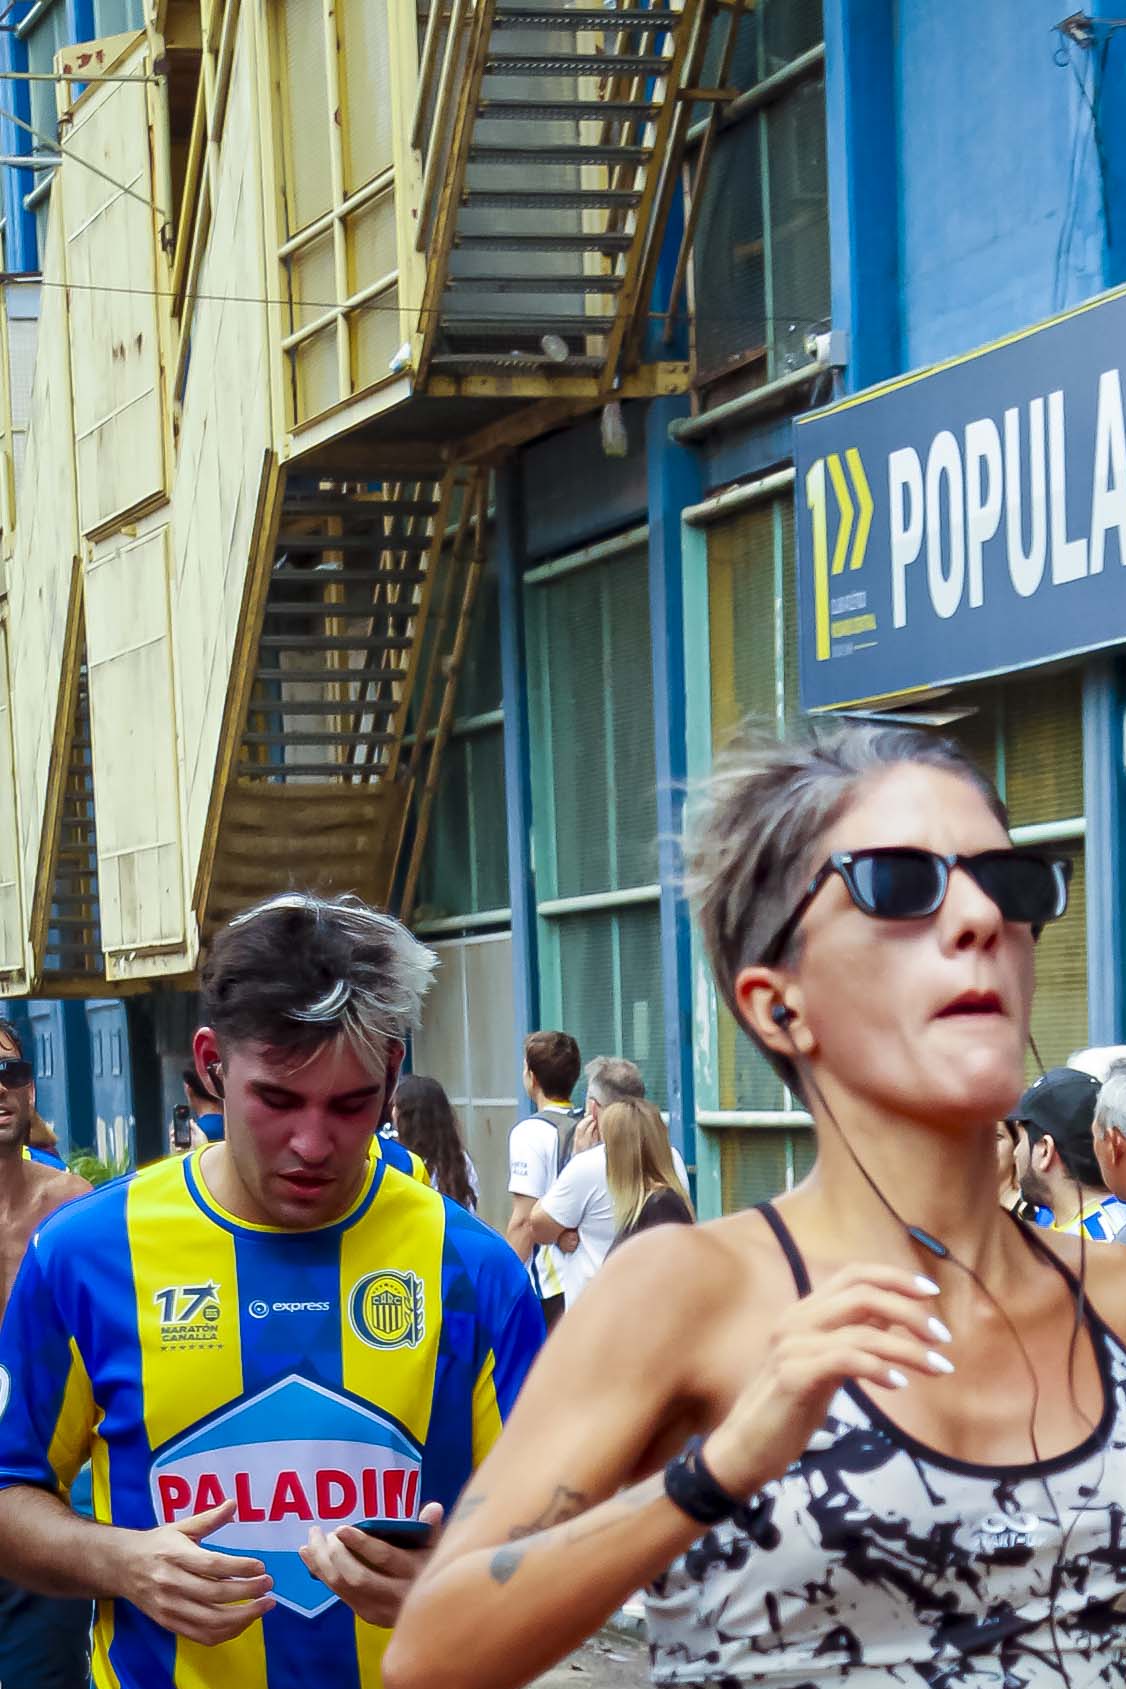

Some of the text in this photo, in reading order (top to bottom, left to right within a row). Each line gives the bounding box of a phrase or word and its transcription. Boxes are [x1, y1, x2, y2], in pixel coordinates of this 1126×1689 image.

[153, 1281, 221, 1325] 17
[272, 1301, 330, 1313] express
[162, 1333, 218, 1342] CANALLA
